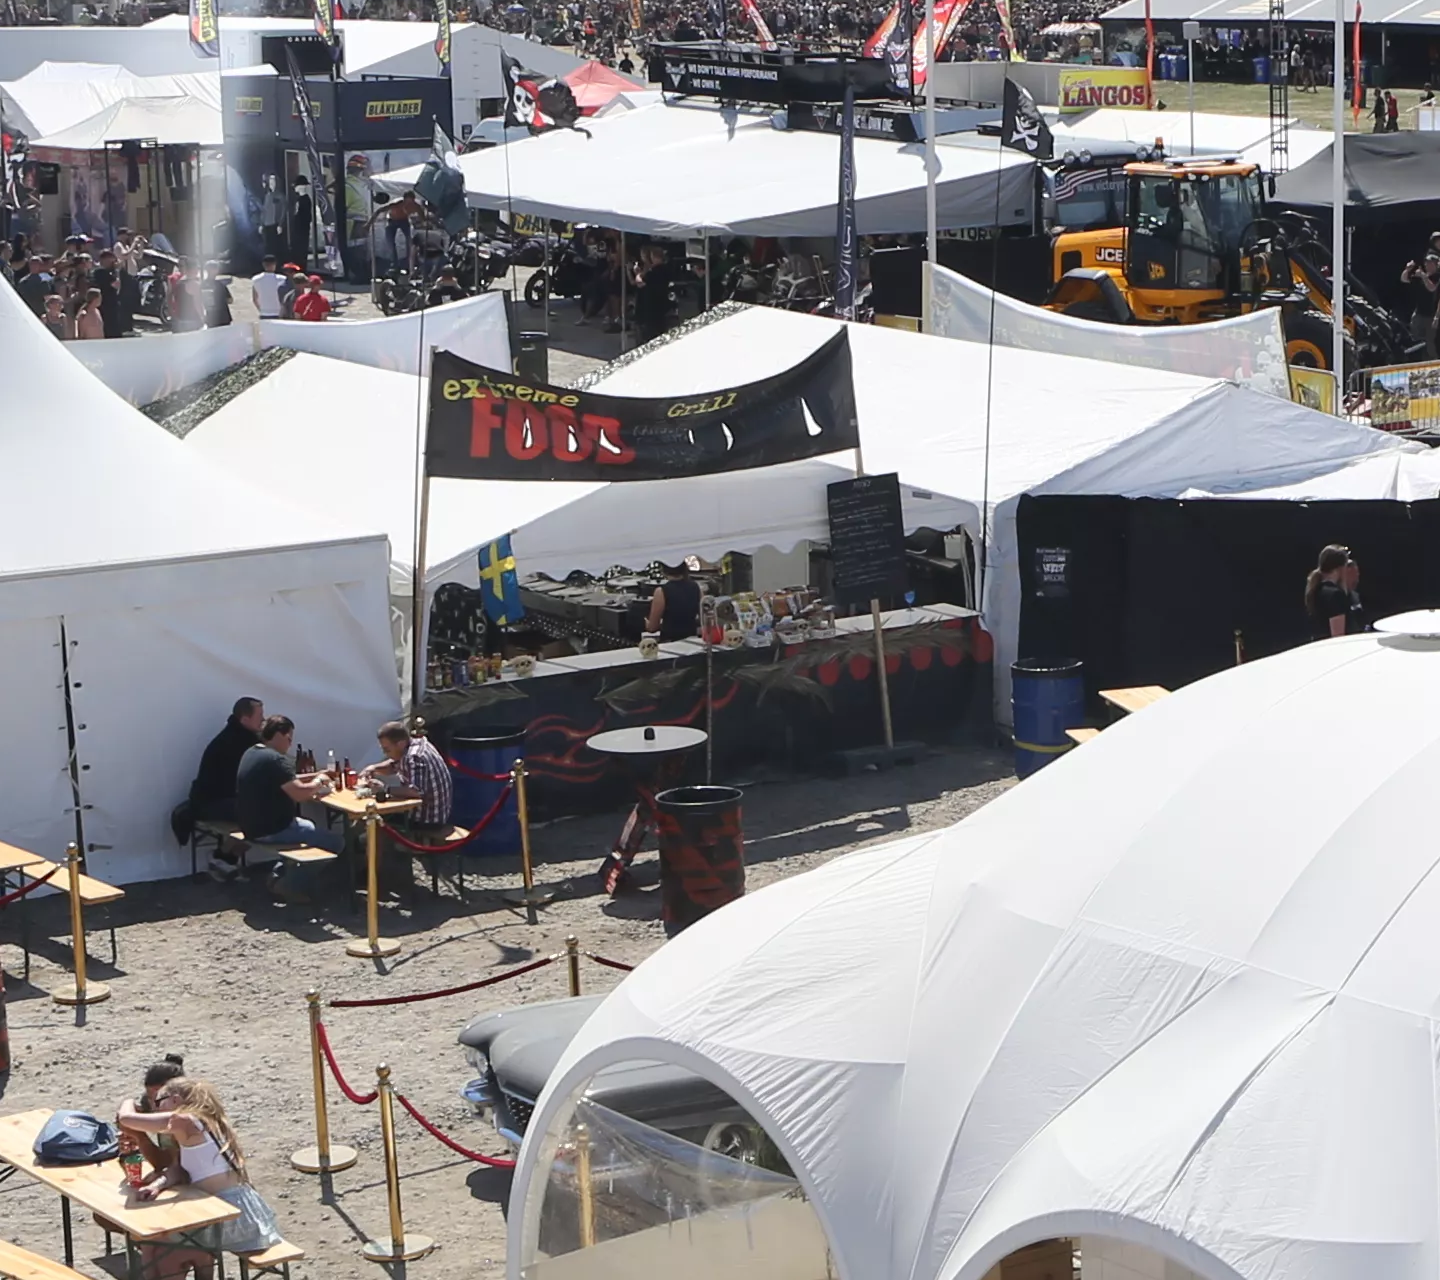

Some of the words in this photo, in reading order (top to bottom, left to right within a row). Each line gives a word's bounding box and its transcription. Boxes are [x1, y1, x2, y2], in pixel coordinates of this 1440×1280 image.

[688, 63, 697, 73] WE
[1063, 84, 1145, 107] LANGOS
[369, 102, 420, 116] BLÅKLÄDER
[442, 376, 579, 408] extreme
[667, 392, 738, 419] Grill
[469, 397, 637, 466] FOOD
